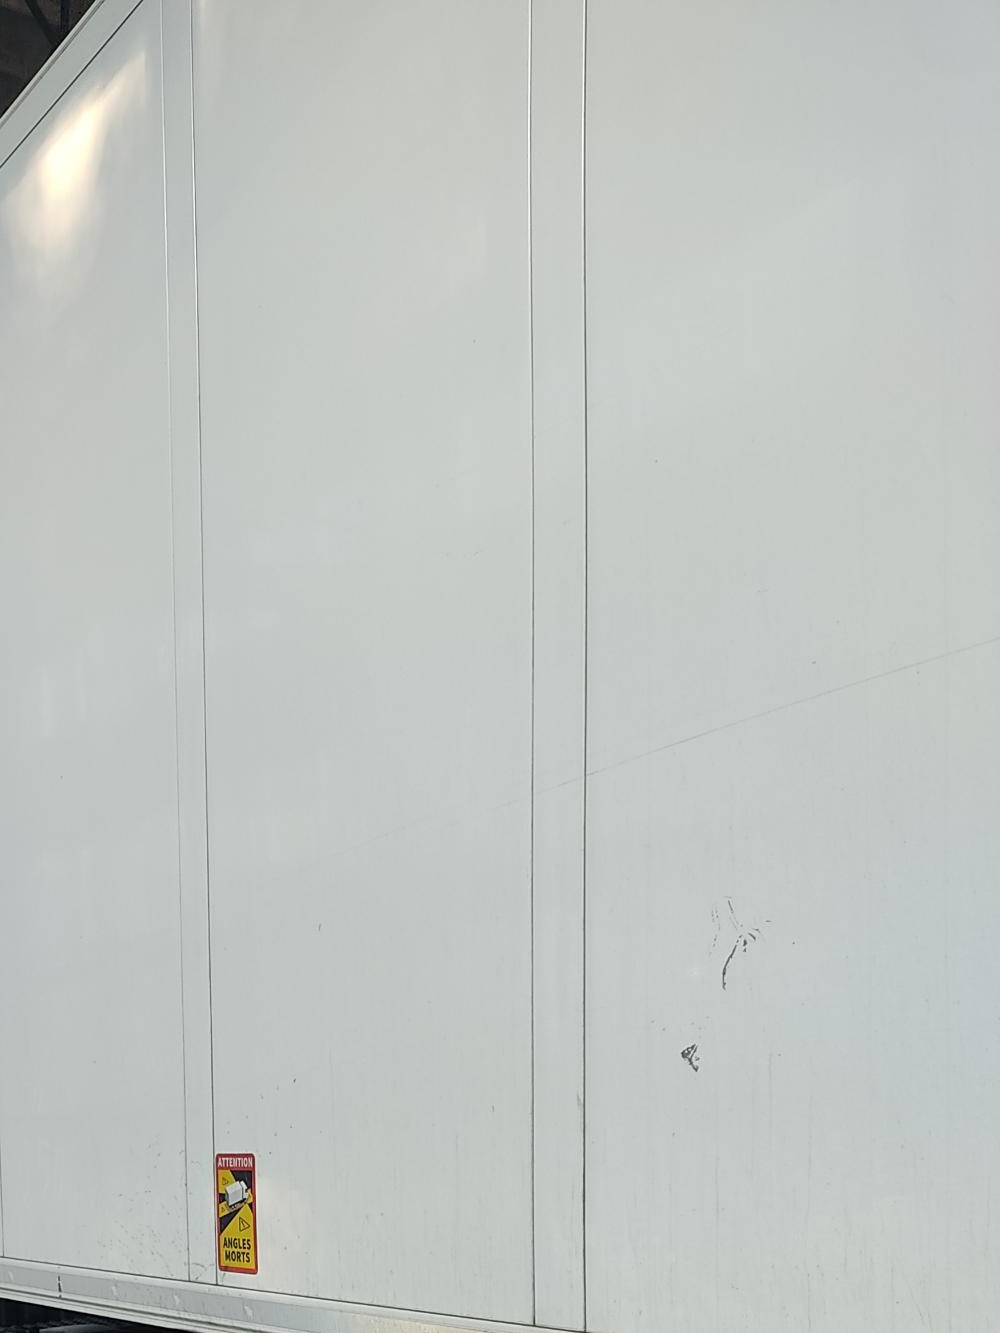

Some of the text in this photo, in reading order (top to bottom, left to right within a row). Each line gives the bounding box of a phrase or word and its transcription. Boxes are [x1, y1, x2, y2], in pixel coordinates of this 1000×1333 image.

[217, 1157, 253, 1168] ATTENTION
[223, 1237, 251, 1250] ANGLES
[224, 1250, 250, 1263] MORTS
